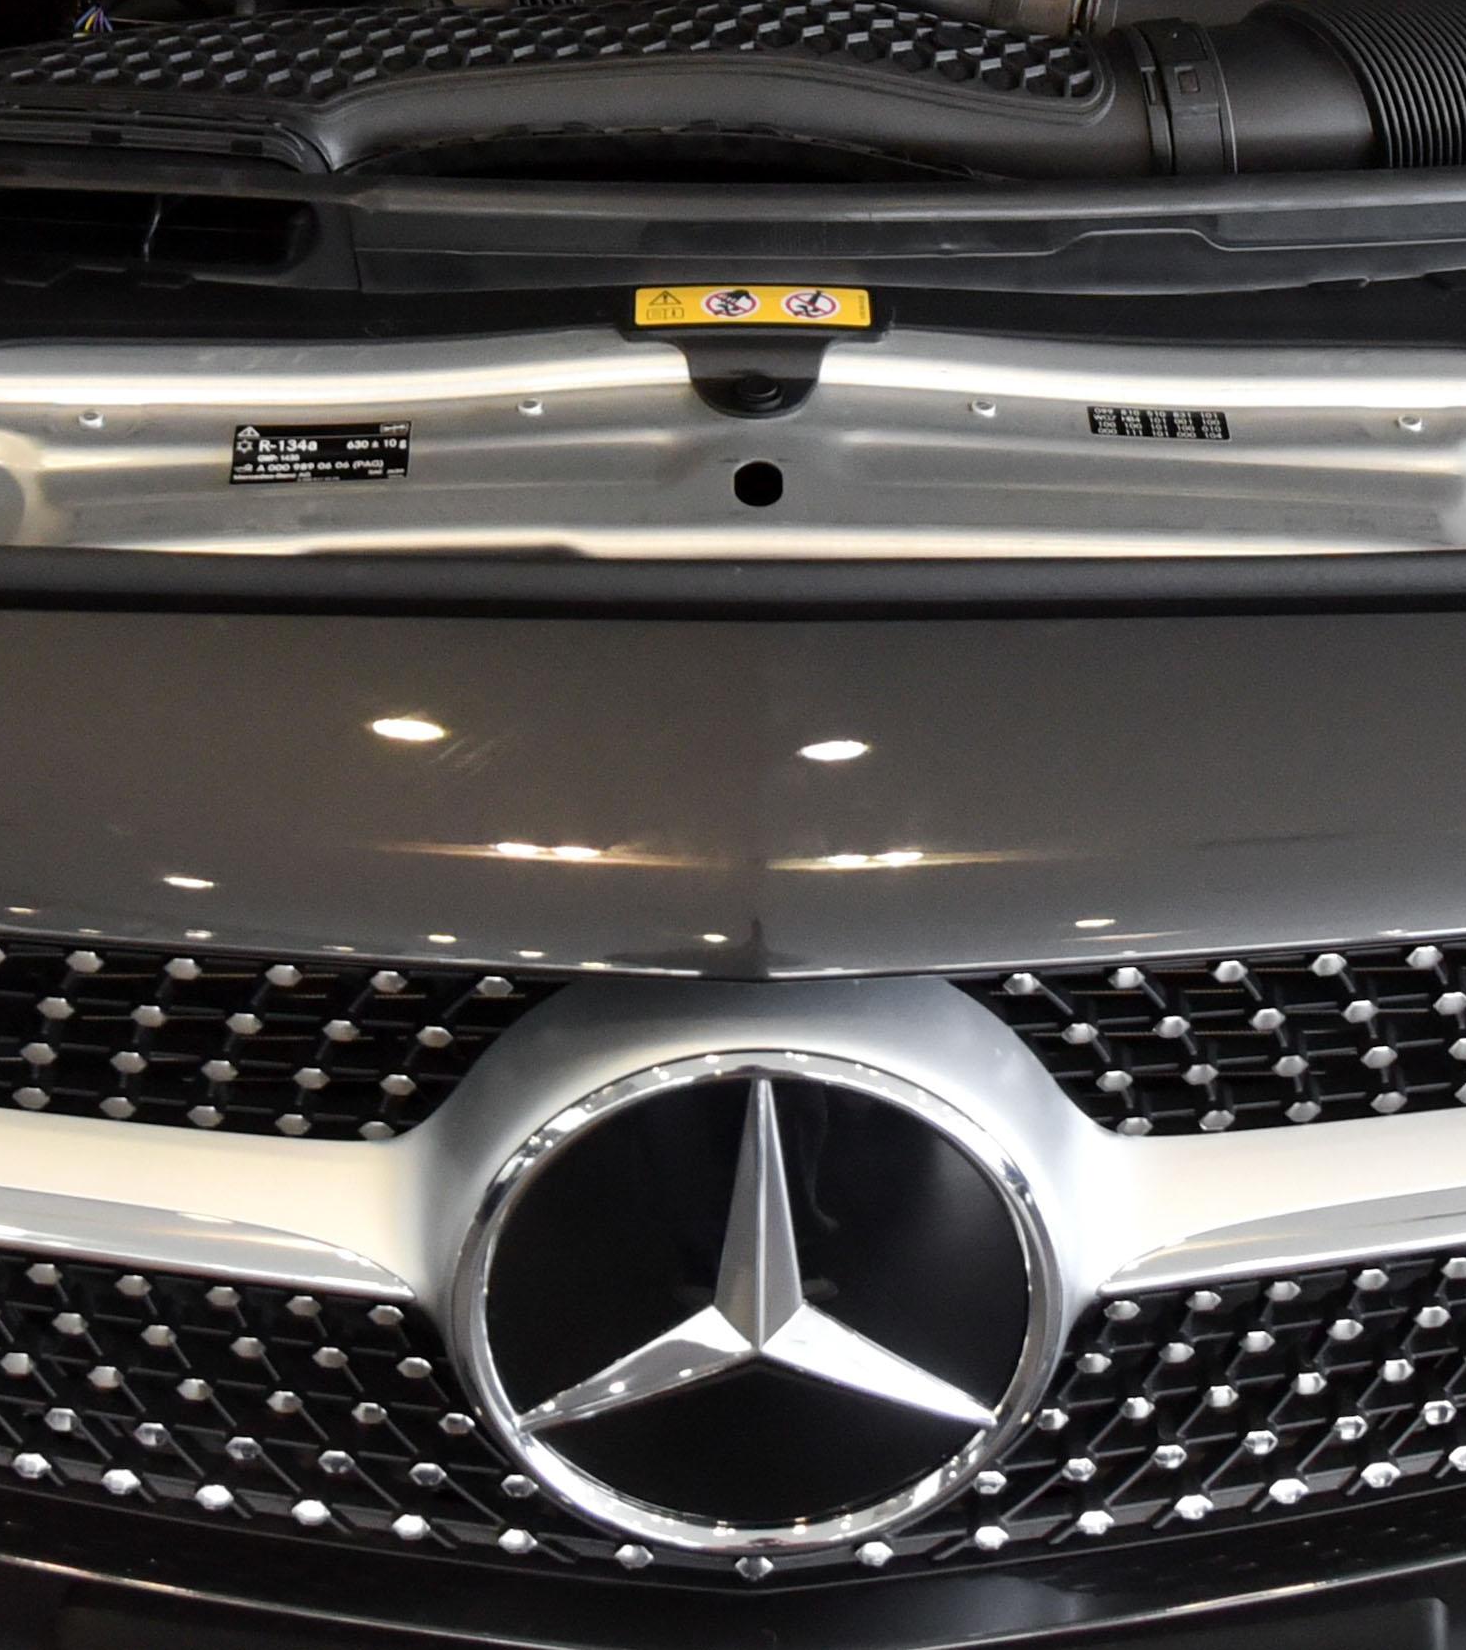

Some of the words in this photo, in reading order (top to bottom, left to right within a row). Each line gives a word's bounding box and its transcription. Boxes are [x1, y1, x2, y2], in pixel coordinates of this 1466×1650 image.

[258, 439, 318, 452] R-134a
[346, 439, 369, 450] 630
[383, 438, 397, 448] 10
[256, 464, 265, 472] A
[267, 463, 290, 472] 000
[352, 459, 384, 470] (PAG)
